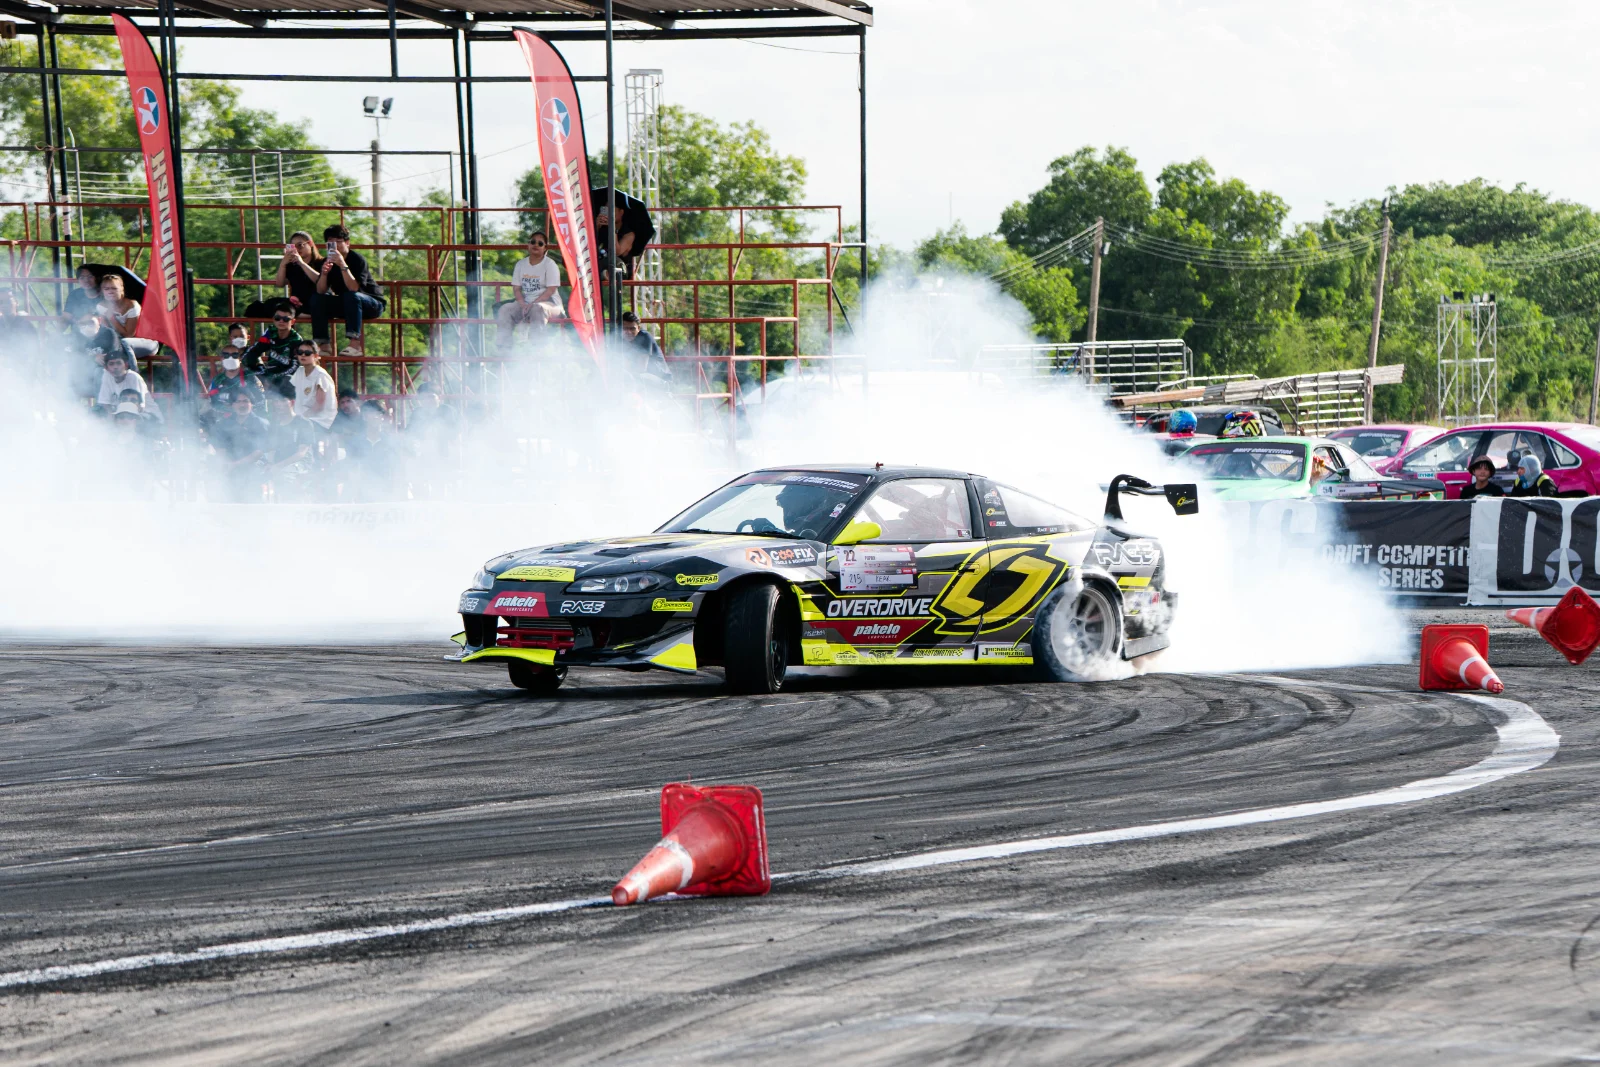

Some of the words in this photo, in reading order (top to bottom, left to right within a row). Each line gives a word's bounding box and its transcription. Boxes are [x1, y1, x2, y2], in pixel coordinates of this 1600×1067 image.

[843, 549, 857, 562] 22
[1321, 544, 1373, 565] DRIFT
[1378, 567, 1445, 589] SERIES
[494, 596, 538, 608] pakelo
[827, 598, 934, 617] OVERDRIVE
[853, 623, 901, 637] pakelo
